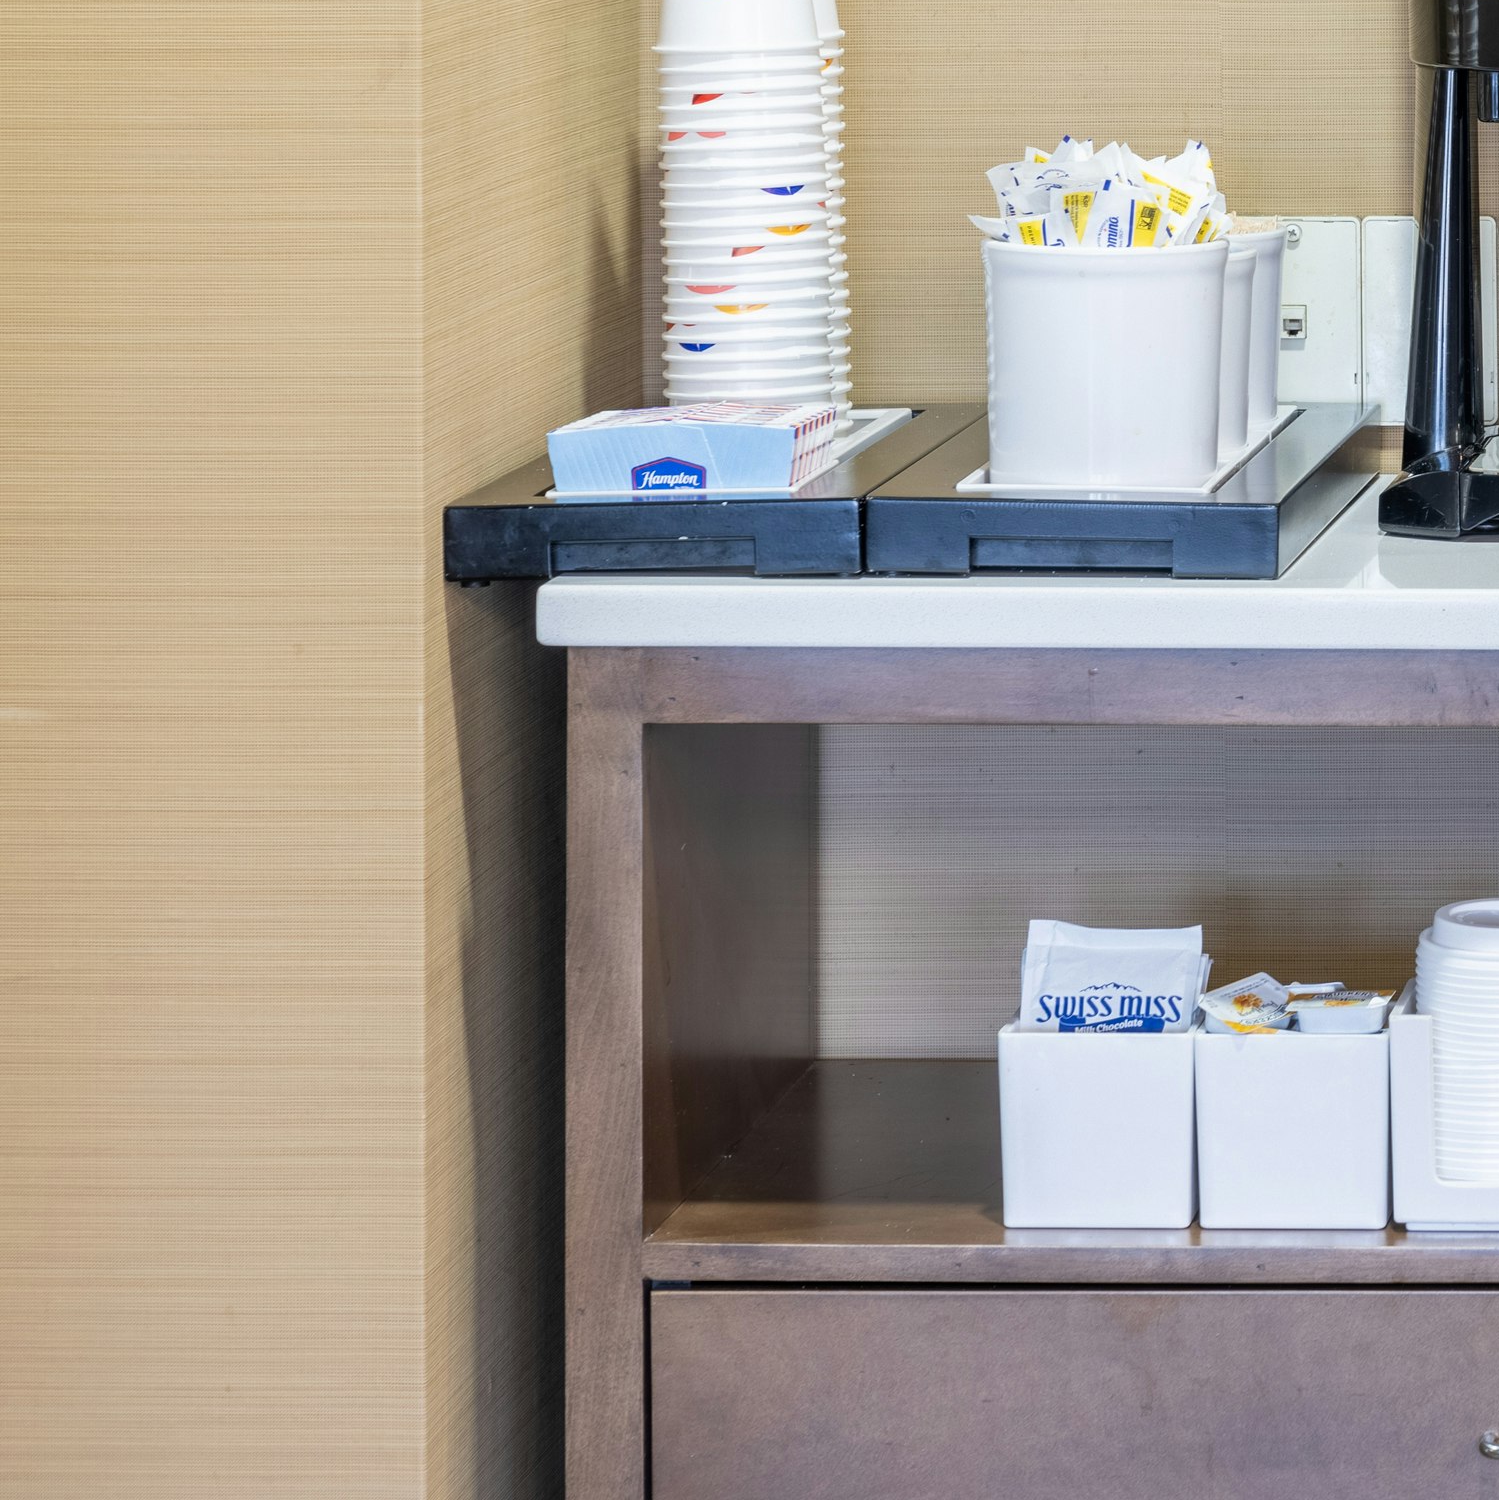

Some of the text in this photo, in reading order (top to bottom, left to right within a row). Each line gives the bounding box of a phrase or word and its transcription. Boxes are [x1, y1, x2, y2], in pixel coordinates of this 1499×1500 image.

[1107, 217, 1119, 247] mino
[638, 470, 700, 489] Hampton
[1096, 1018, 1144, 1033] Chocolate
